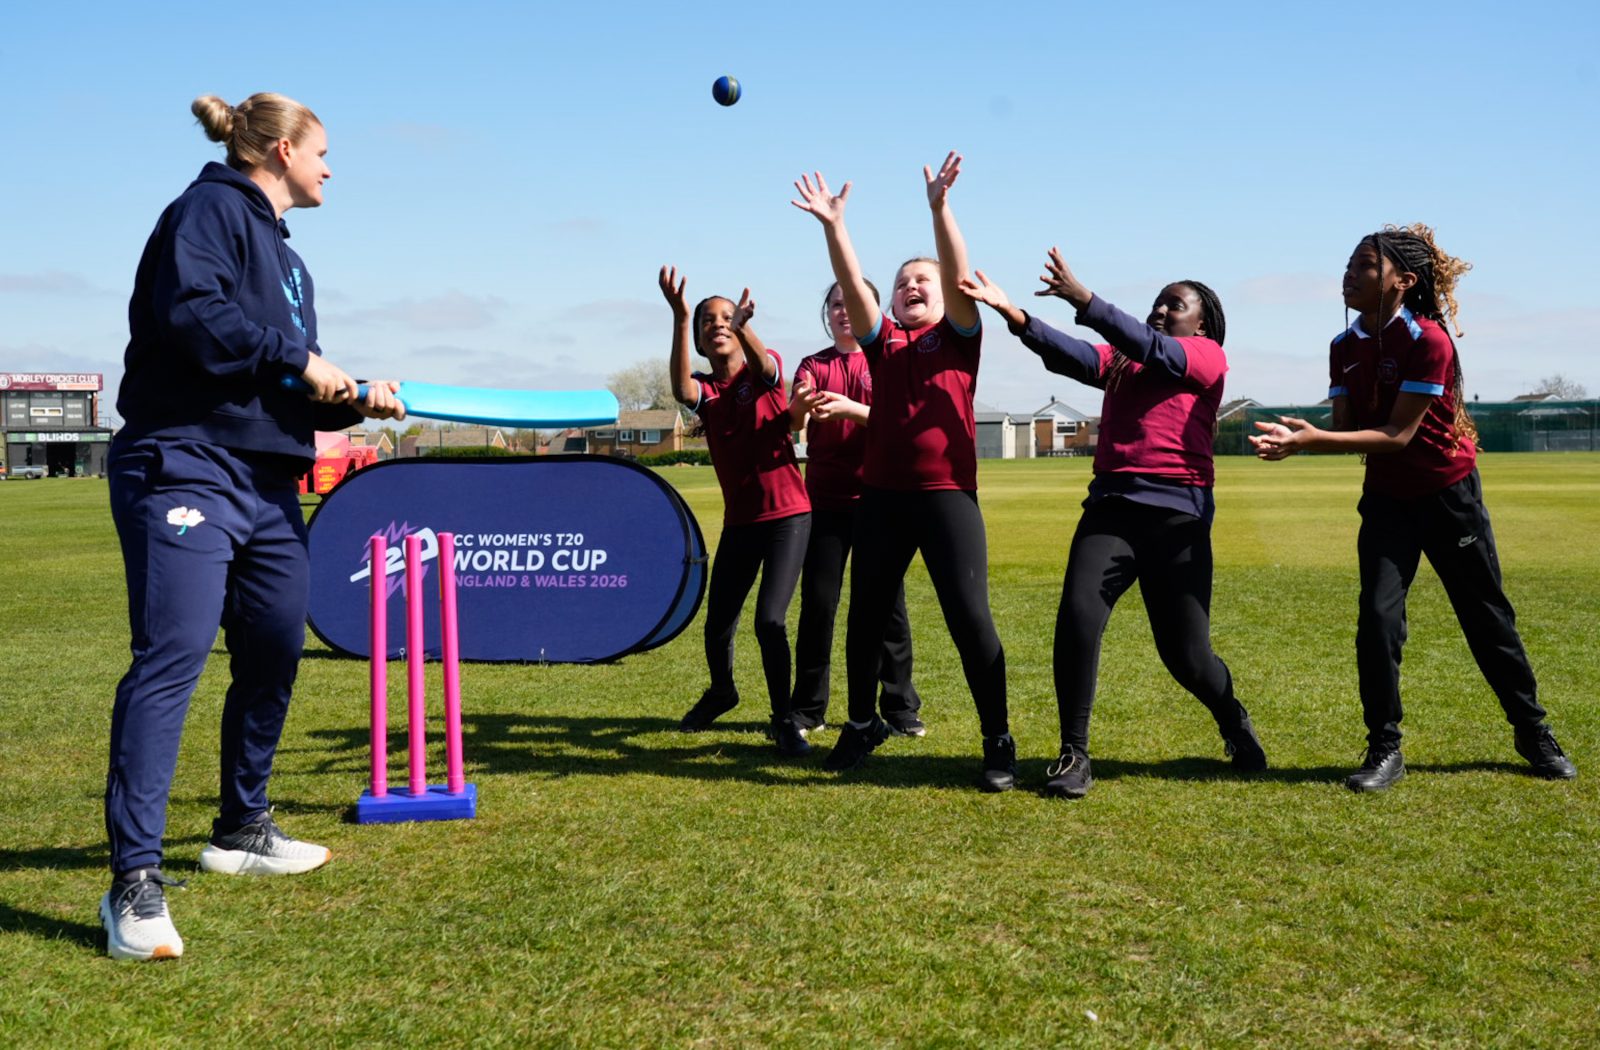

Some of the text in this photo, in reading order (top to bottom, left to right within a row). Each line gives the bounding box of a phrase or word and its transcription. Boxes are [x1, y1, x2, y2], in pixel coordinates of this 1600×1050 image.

[12, 374, 98, 384] MORLEY CRICKET CLUB
[38, 432, 80, 442] BLINDS
[453, 533, 584, 546] CC WOMEN'S T20
[453, 549, 607, 571] WORLD CUP
[455, 575, 628, 588] NGLAND & WALES 2026
